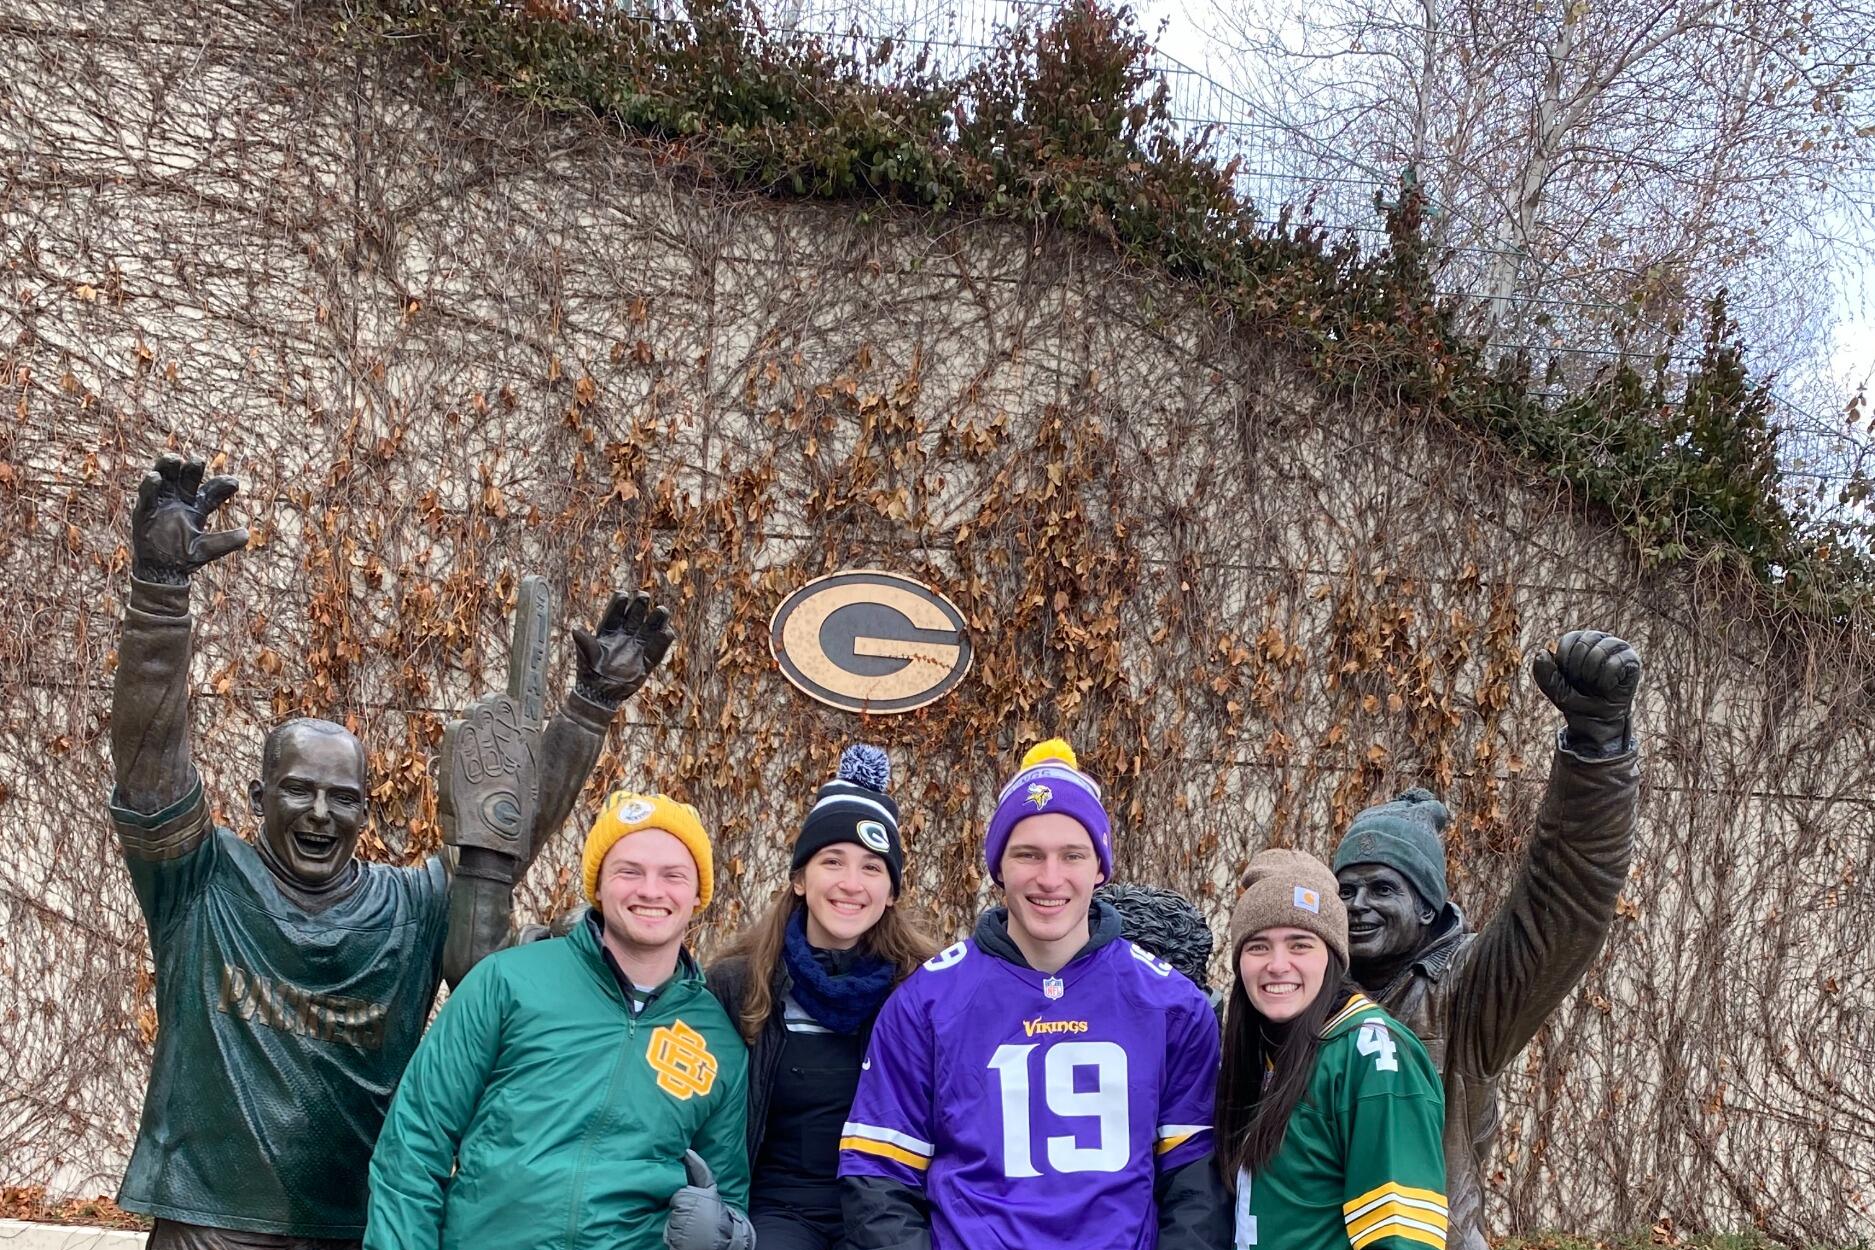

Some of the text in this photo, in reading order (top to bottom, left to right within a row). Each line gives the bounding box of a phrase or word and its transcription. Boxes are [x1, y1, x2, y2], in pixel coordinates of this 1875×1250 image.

[777, 578, 966, 706] G
[857, 820, 890, 852] G
[1356, 1017, 1399, 1072] 4
[987, 1041, 1130, 1178] 19
